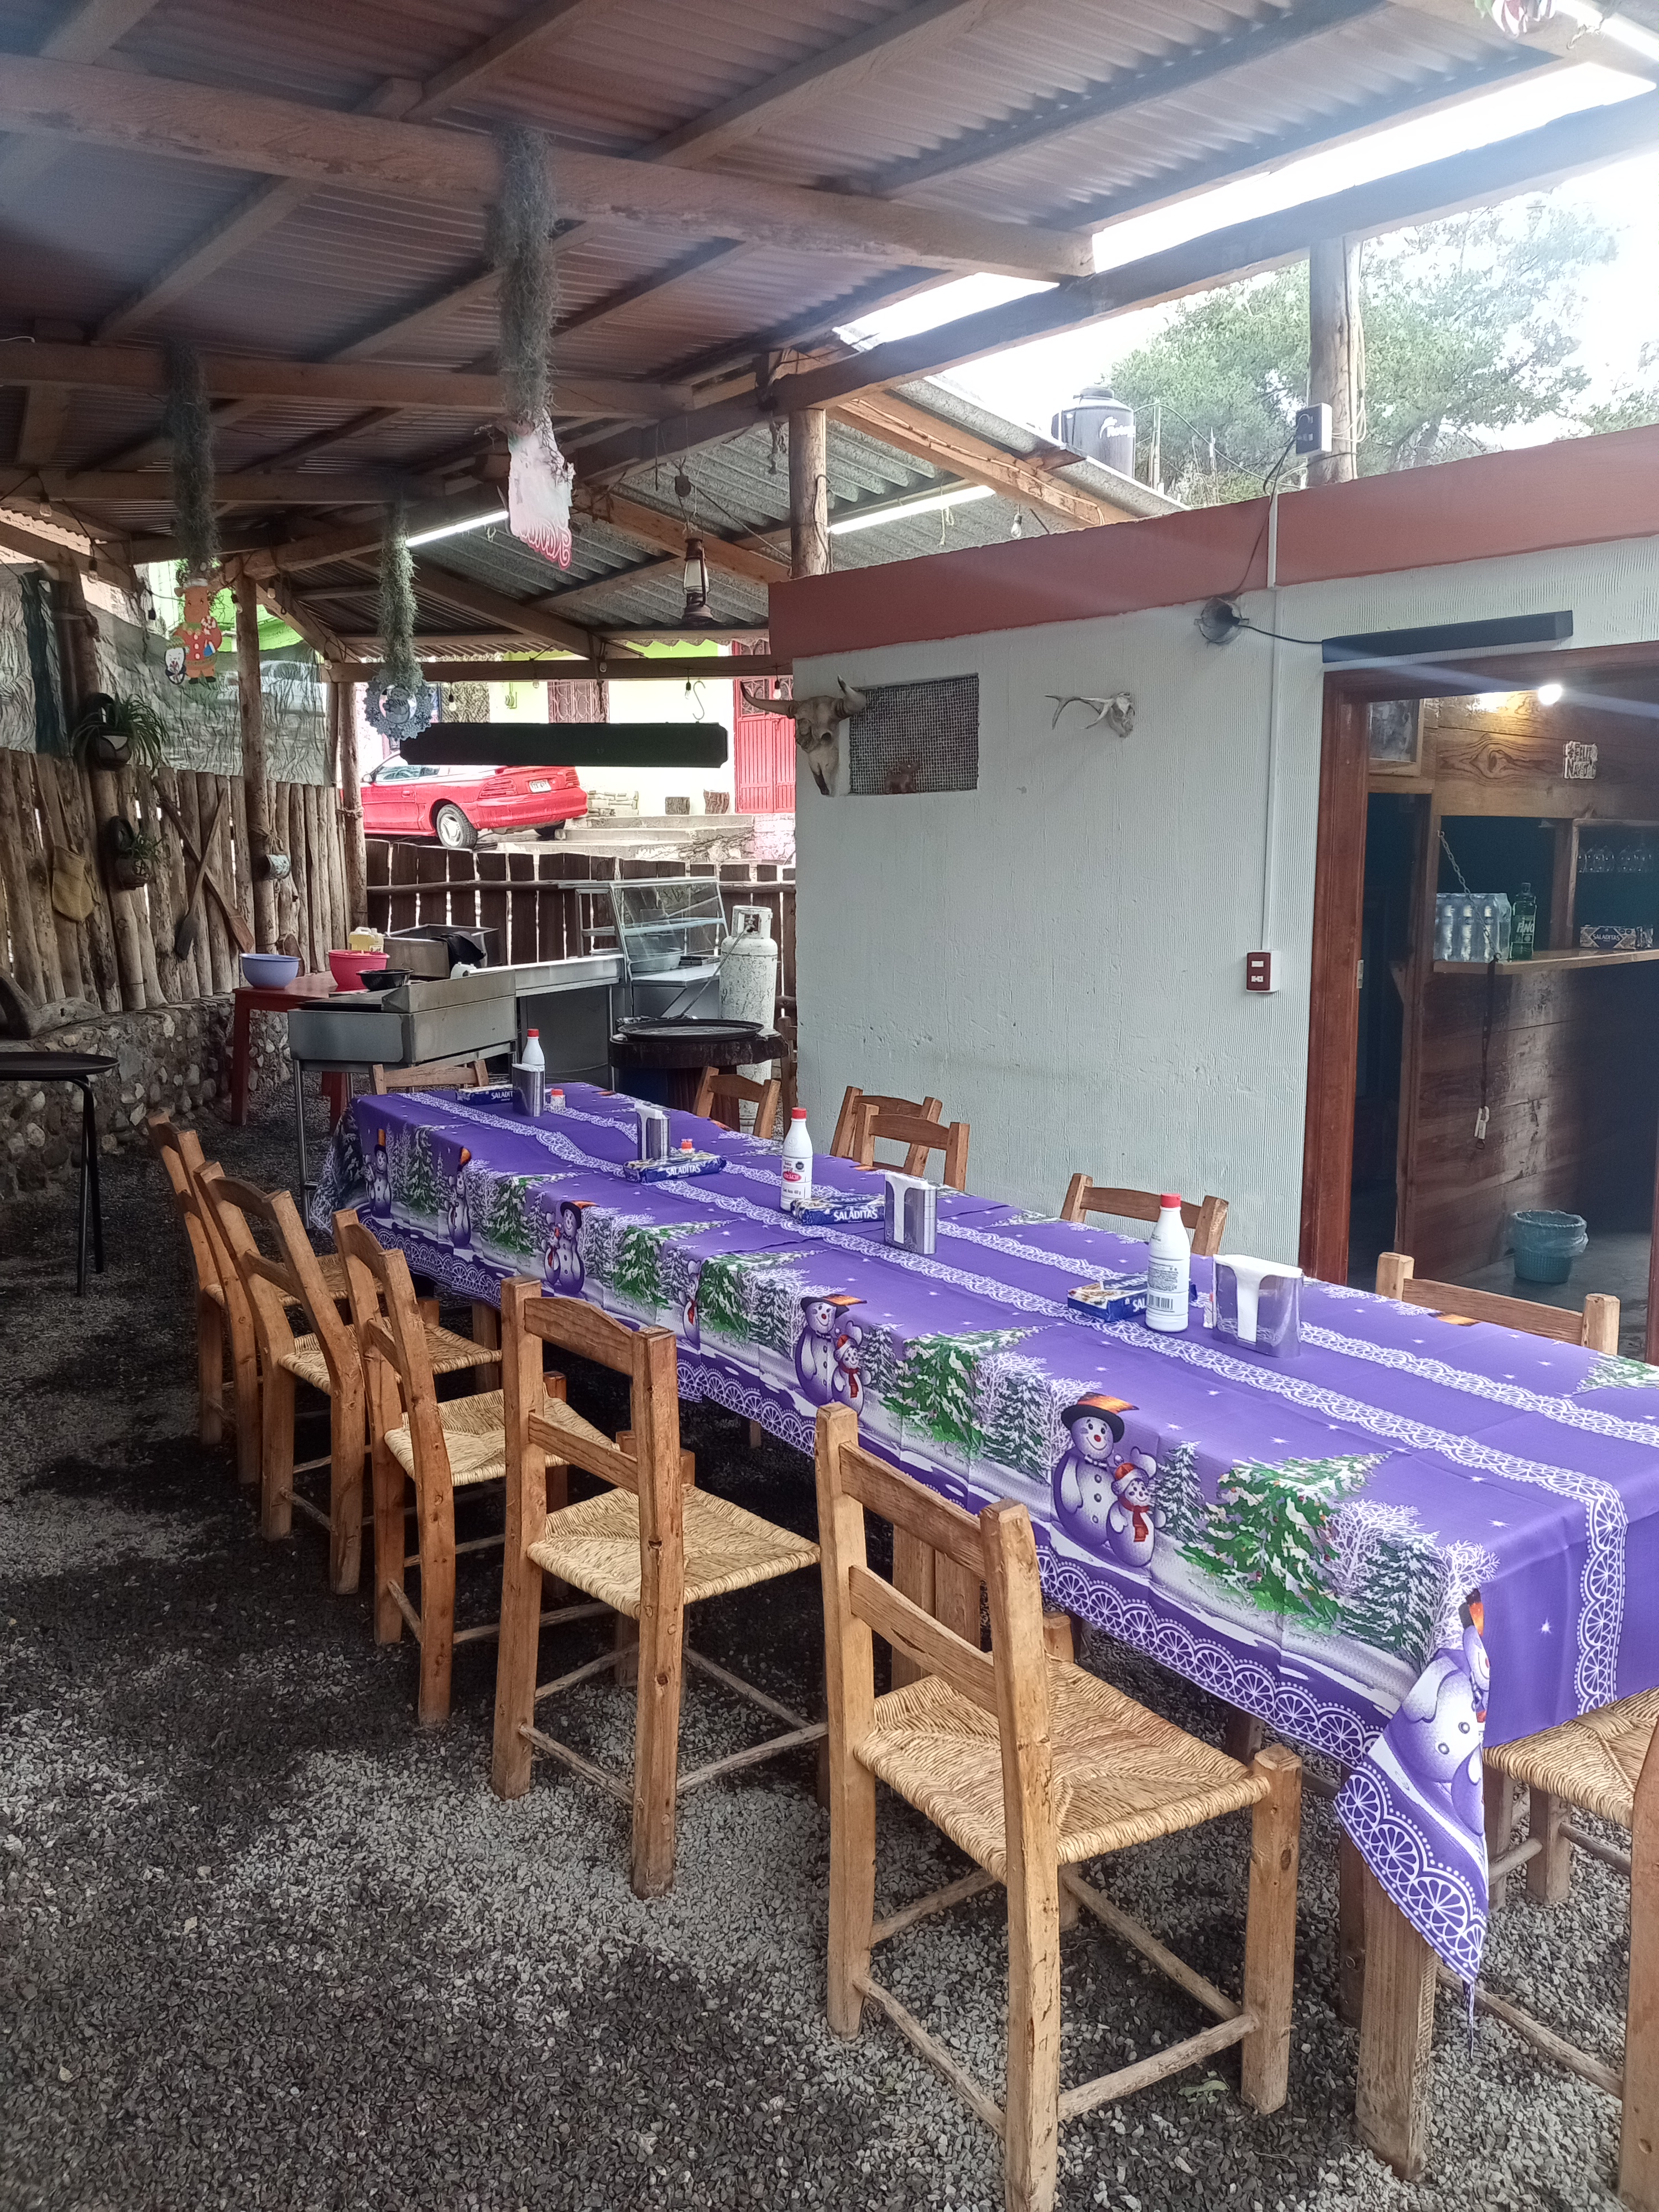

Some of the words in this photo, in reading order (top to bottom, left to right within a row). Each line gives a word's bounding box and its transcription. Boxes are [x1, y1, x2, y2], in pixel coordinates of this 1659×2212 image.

[491, 1091, 513, 1100] SALADIT
[665, 1164, 701, 1177] SALADITAS
[833, 1210, 879, 1222] SALADITAS
